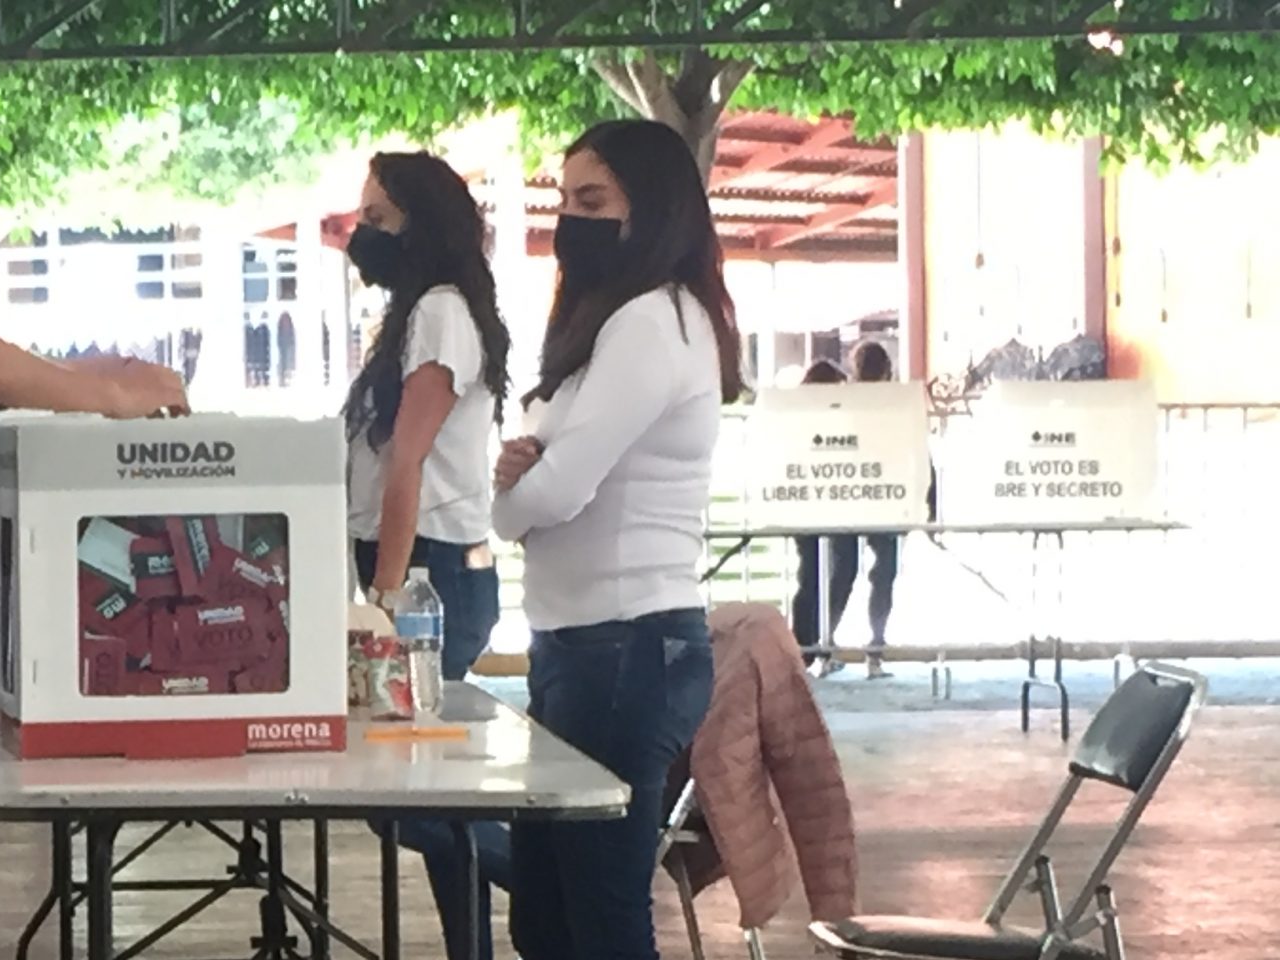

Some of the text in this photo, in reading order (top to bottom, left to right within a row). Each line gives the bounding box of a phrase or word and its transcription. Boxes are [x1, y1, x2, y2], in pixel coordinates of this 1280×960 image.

[116, 441, 235, 464] UNIDAD
[117, 469, 127, 479] Y
[786, 462, 882, 479] EL VOTO ES
[1004, 460, 1100, 476] EL VOTO ES
[763, 484, 906, 501] LIBRE Y SECRETO
[1032, 483, 1042, 497] Y
[1046, 481, 1123, 498] SECRETO
[247, 722, 330, 739] morena
